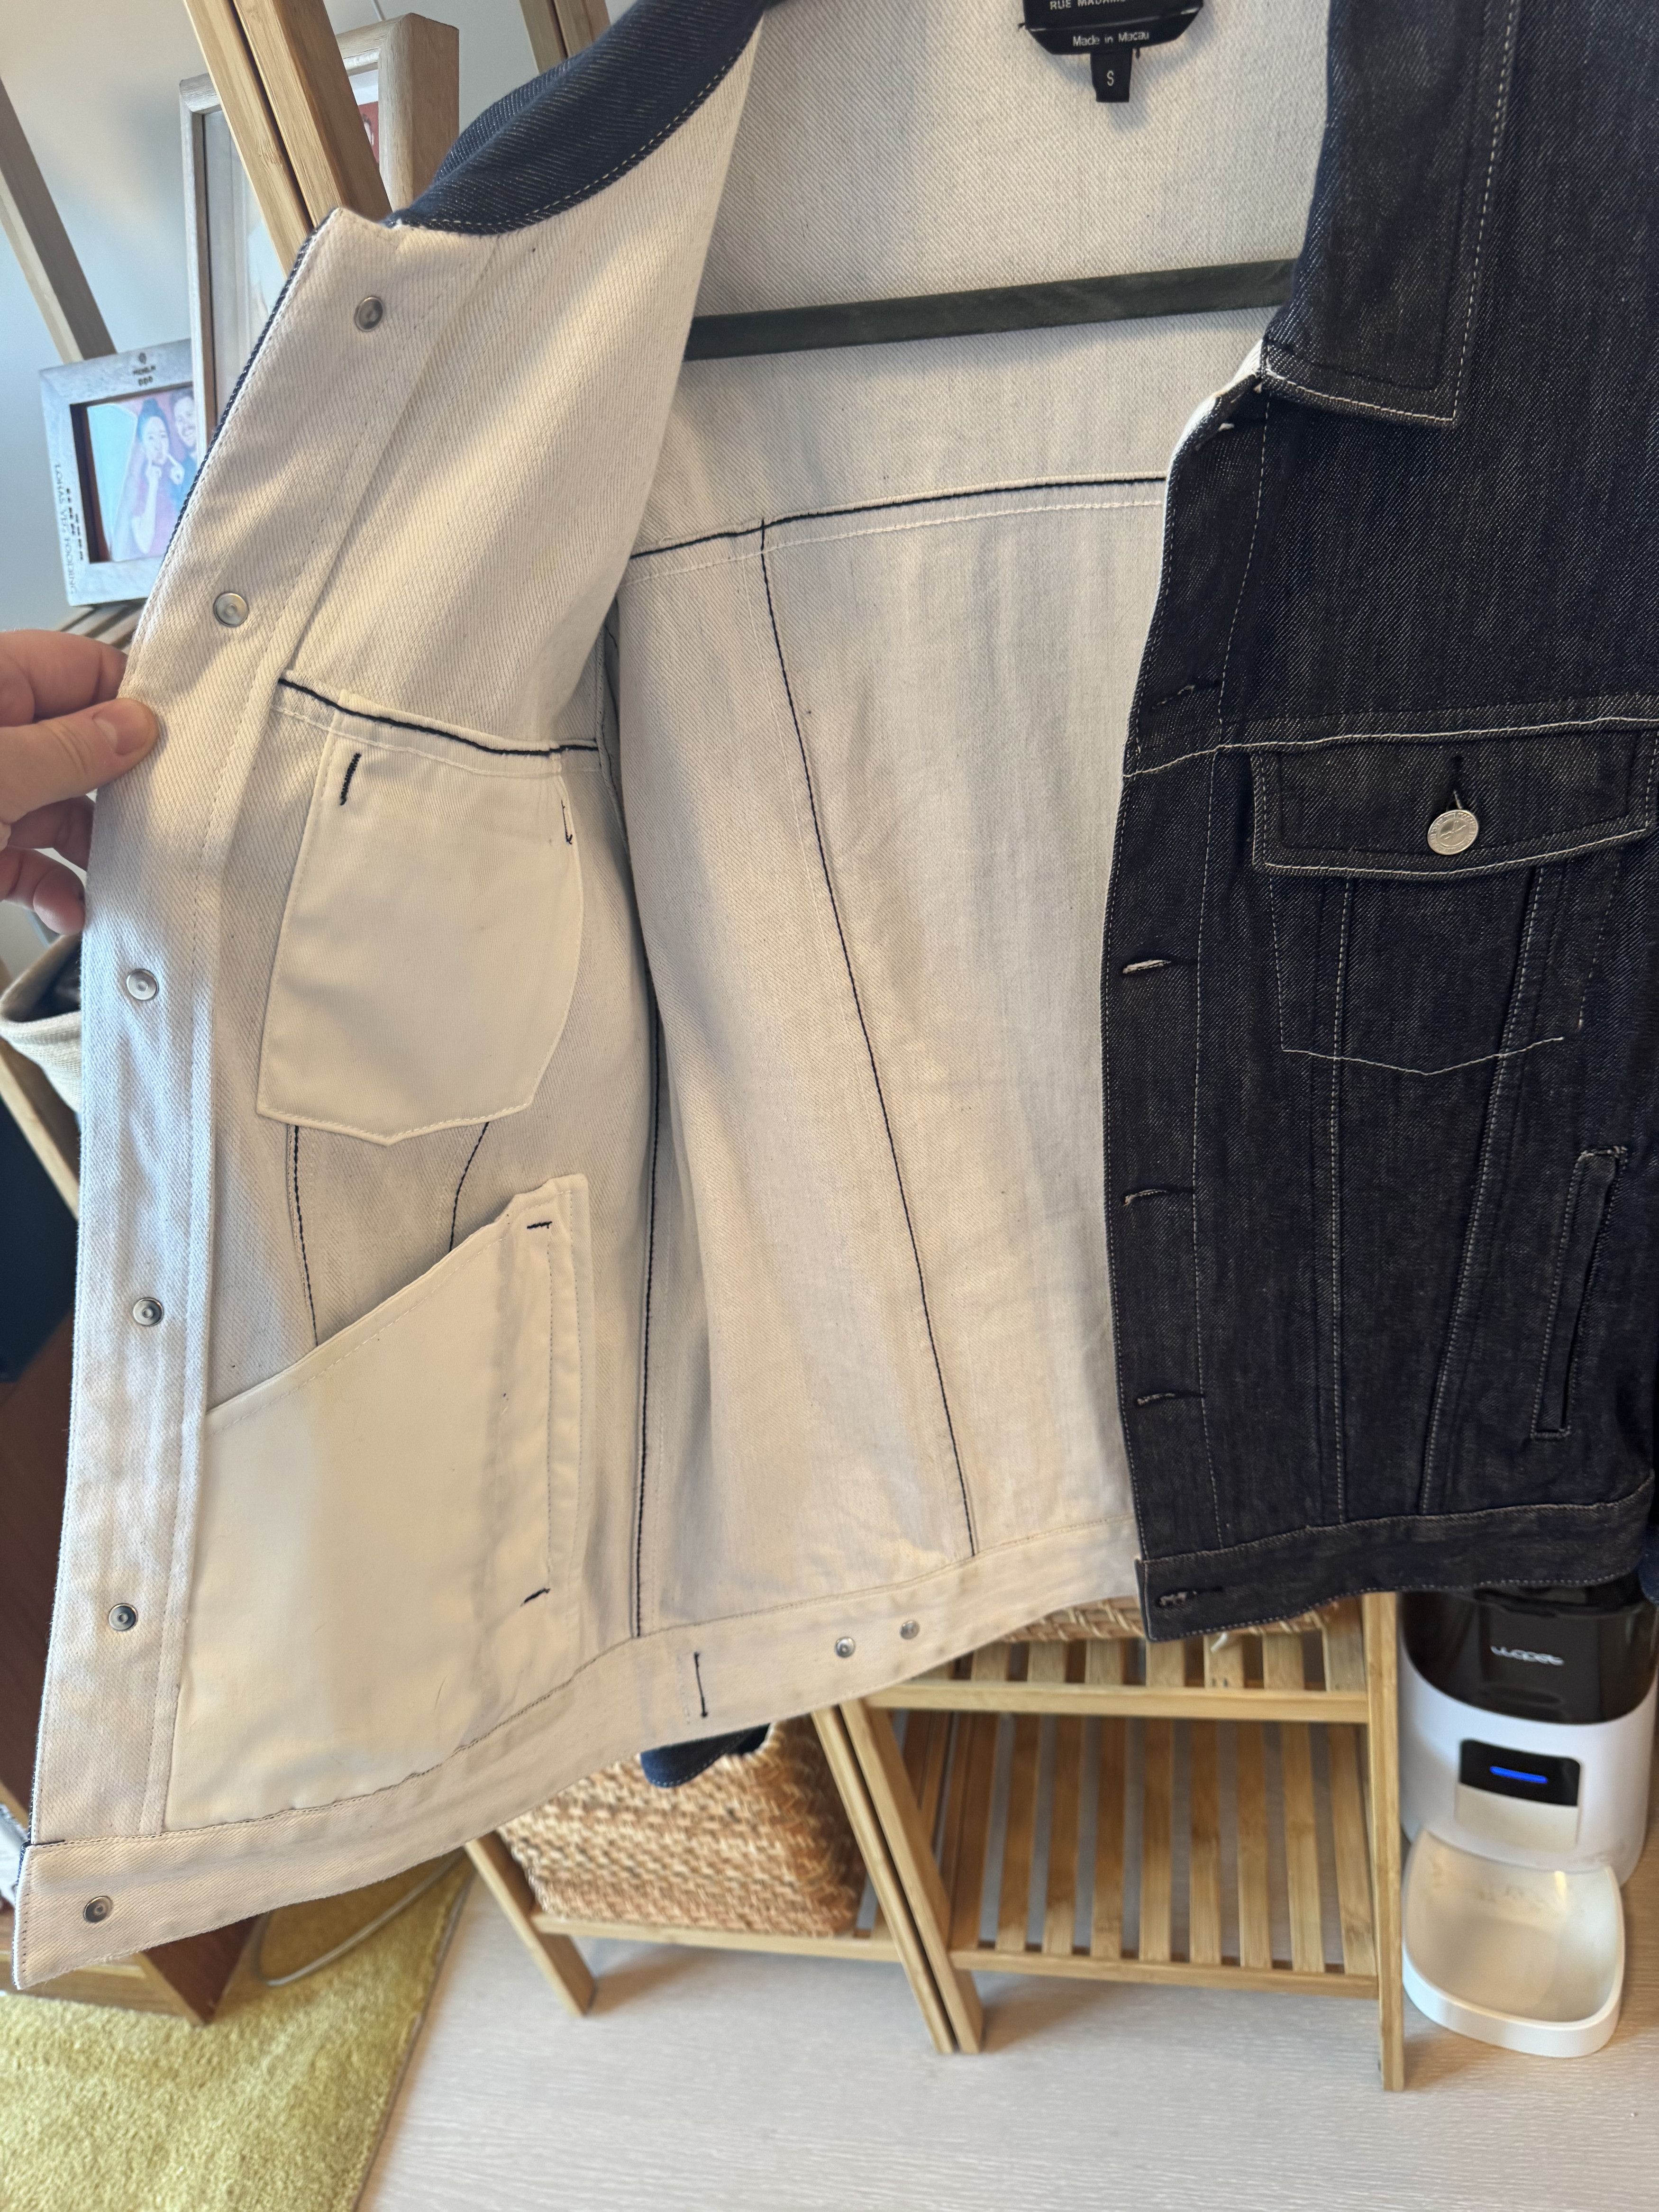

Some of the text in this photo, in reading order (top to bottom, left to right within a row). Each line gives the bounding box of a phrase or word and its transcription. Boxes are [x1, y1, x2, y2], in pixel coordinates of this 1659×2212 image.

[1050, 0, 1071, 10] RUE
[1073, 31, 1149, 46] Made in Macau
[1107, 70, 1114, 86] S
